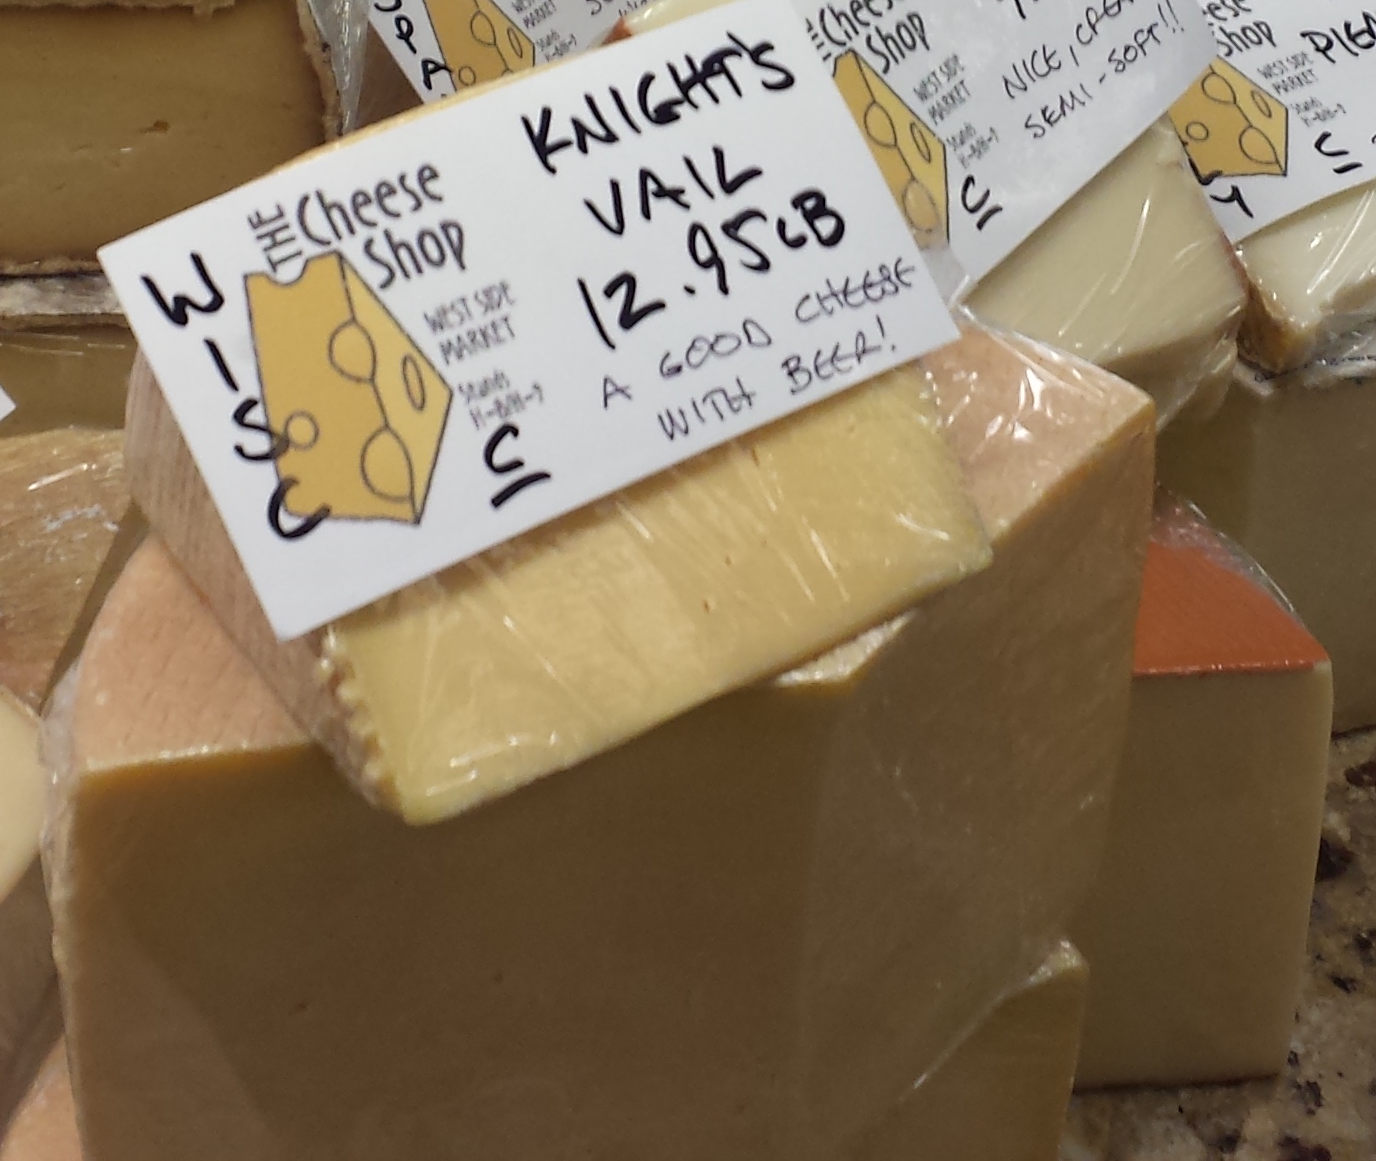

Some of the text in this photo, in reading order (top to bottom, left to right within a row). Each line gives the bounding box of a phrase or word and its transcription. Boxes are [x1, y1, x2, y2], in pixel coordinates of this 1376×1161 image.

[865, 10, 931, 75] Shop
[520, 30, 799, 177] KNIGHT'S
[246, 162, 448, 273] THE Cheese
[583, 146, 765, 238] VAIL
[362, 214, 471, 291] Shop
[424, 297, 473, 334] WEST
[439, 314, 516, 366] MARKET
[599, 258, 921, 411] A GOOD CHEESE
[140, 249, 332, 543] WISC
[658, 383, 761, 443] WITH
